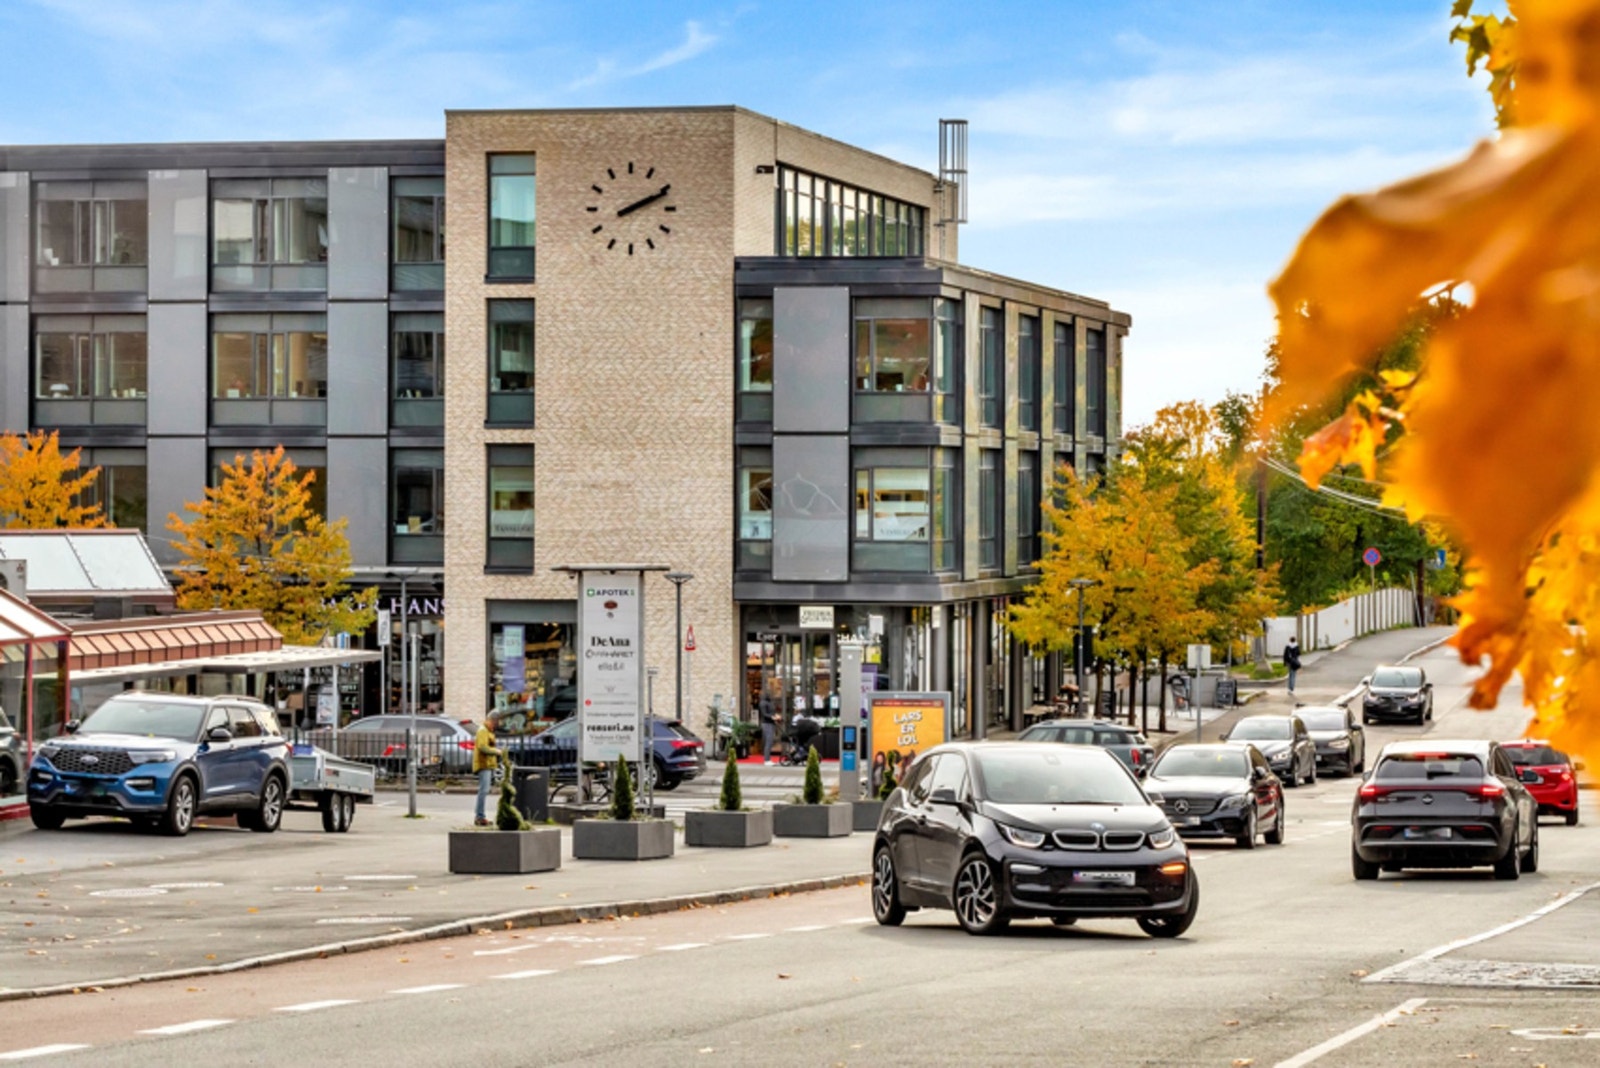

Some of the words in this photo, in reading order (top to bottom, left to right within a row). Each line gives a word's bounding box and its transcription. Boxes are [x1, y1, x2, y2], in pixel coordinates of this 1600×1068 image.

[893, 710, 923, 724] LARS
[587, 722, 635, 732] renseri.no
[901, 723, 916, 734] ER
[897, 735, 918, 746] LOL
